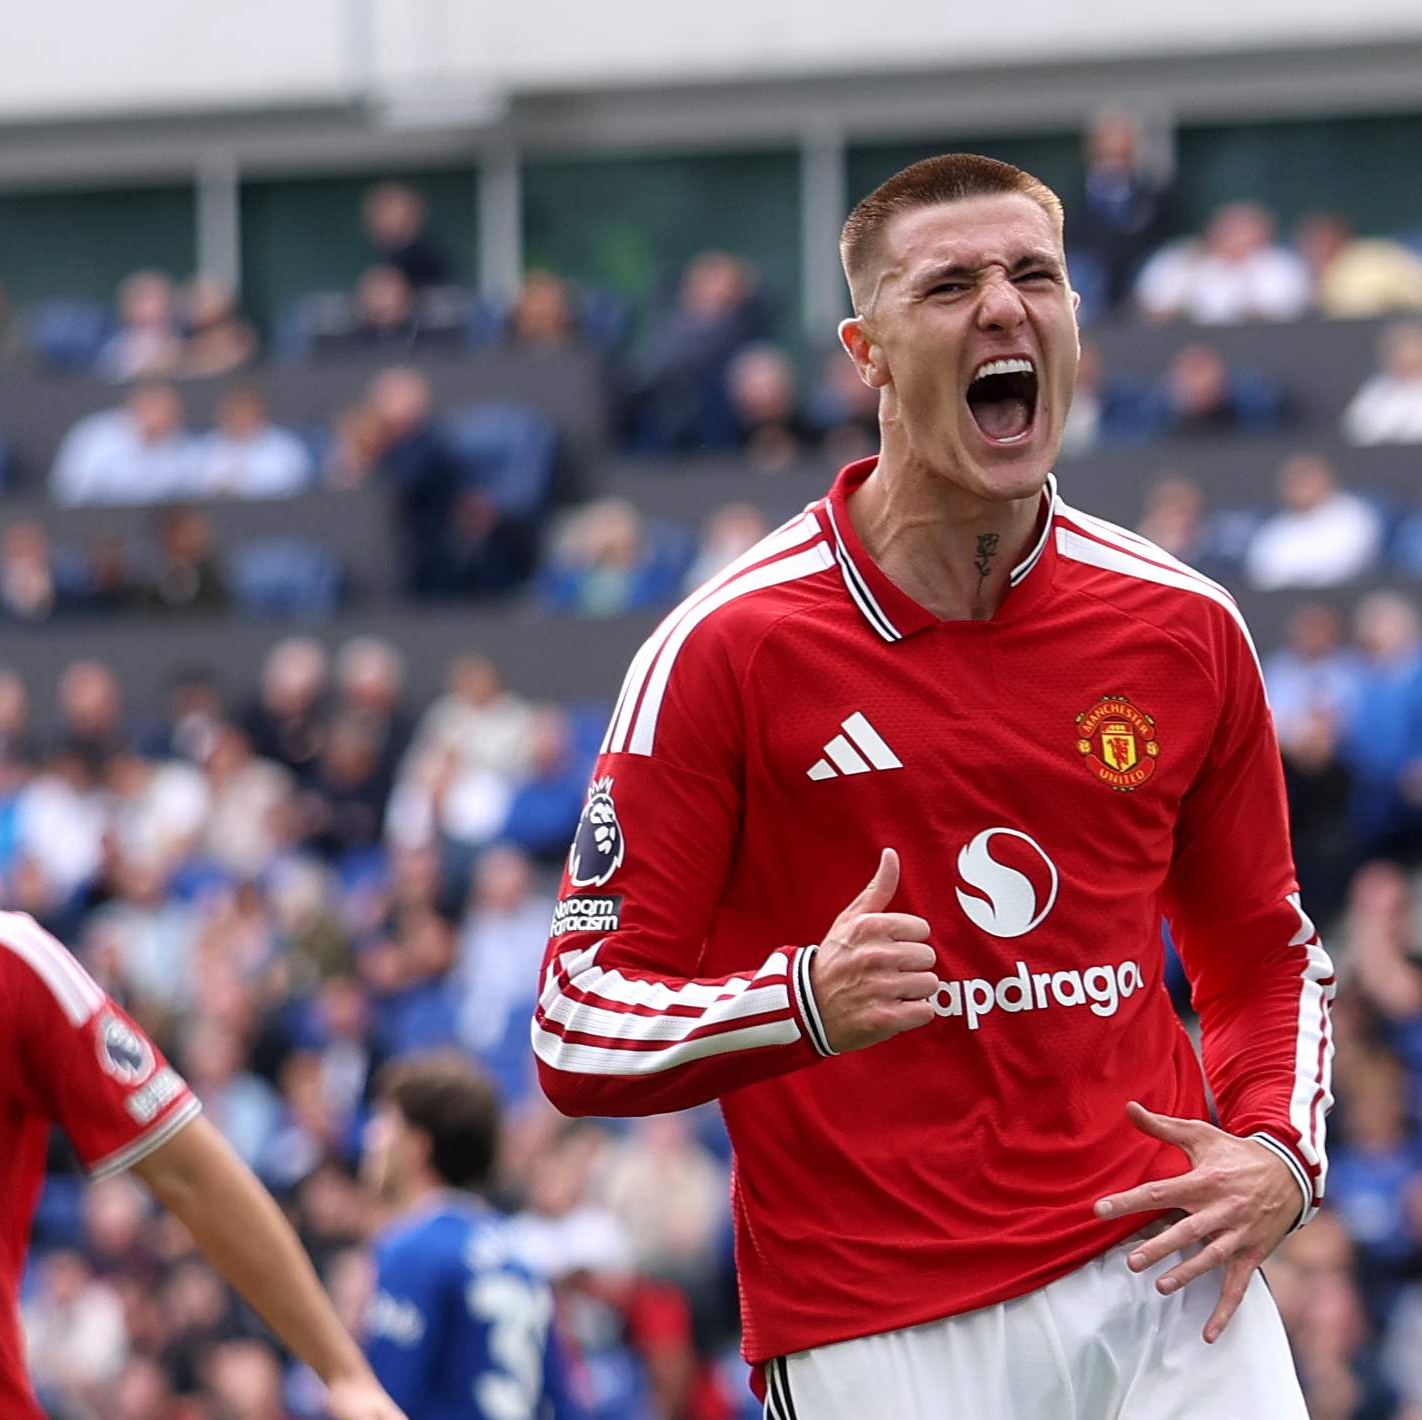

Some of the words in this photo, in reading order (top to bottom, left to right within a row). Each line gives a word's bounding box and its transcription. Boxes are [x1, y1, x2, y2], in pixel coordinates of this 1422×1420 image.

[1082, 703, 1149, 735] MANCHESTER
[1099, 768, 1145, 784] UNITED
[924, 960, 1145, 1031] apdrago
